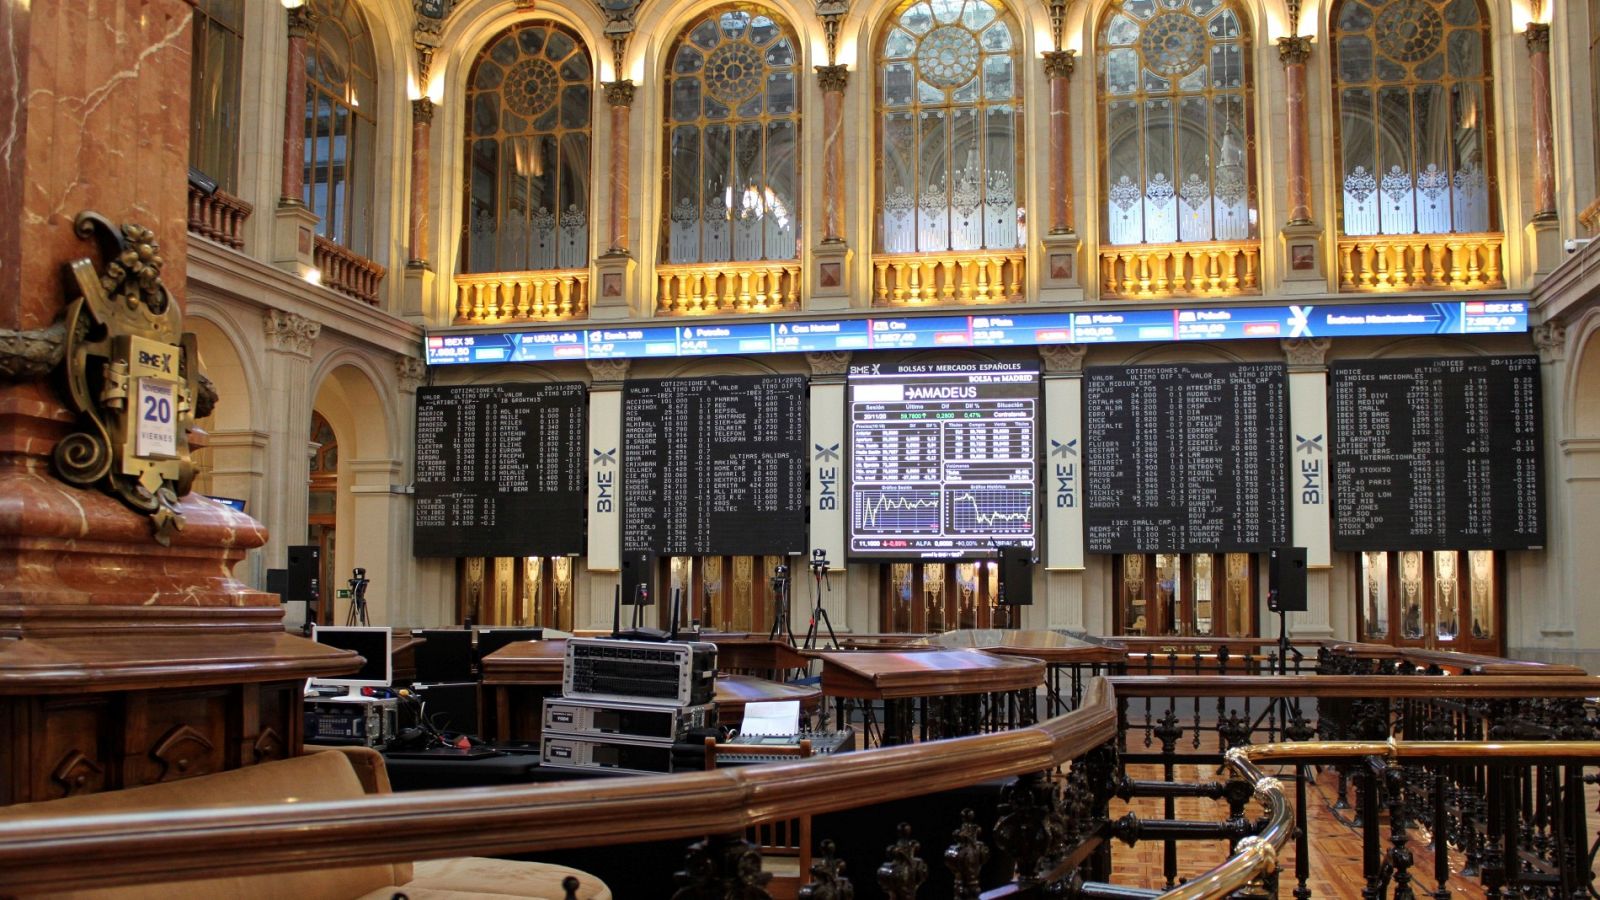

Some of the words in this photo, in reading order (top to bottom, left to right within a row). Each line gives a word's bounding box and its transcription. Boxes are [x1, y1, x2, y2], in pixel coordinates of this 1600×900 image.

[444, 338, 464, 346] IBEX
[464, 337, 474, 346] 35
[850, 366, 870, 374] BME
[979, 362, 1021, 371] ESPAÑOLES
[914, 387, 977, 399] AMADEUS
[144, 396, 170, 423] 20
[142, 432, 172, 442] VIERNES
[597, 471, 612, 512] BME
[820, 467, 835, 510] BME
[1057, 464, 1073, 507] BME
[1302, 460, 1319, 504] BME
